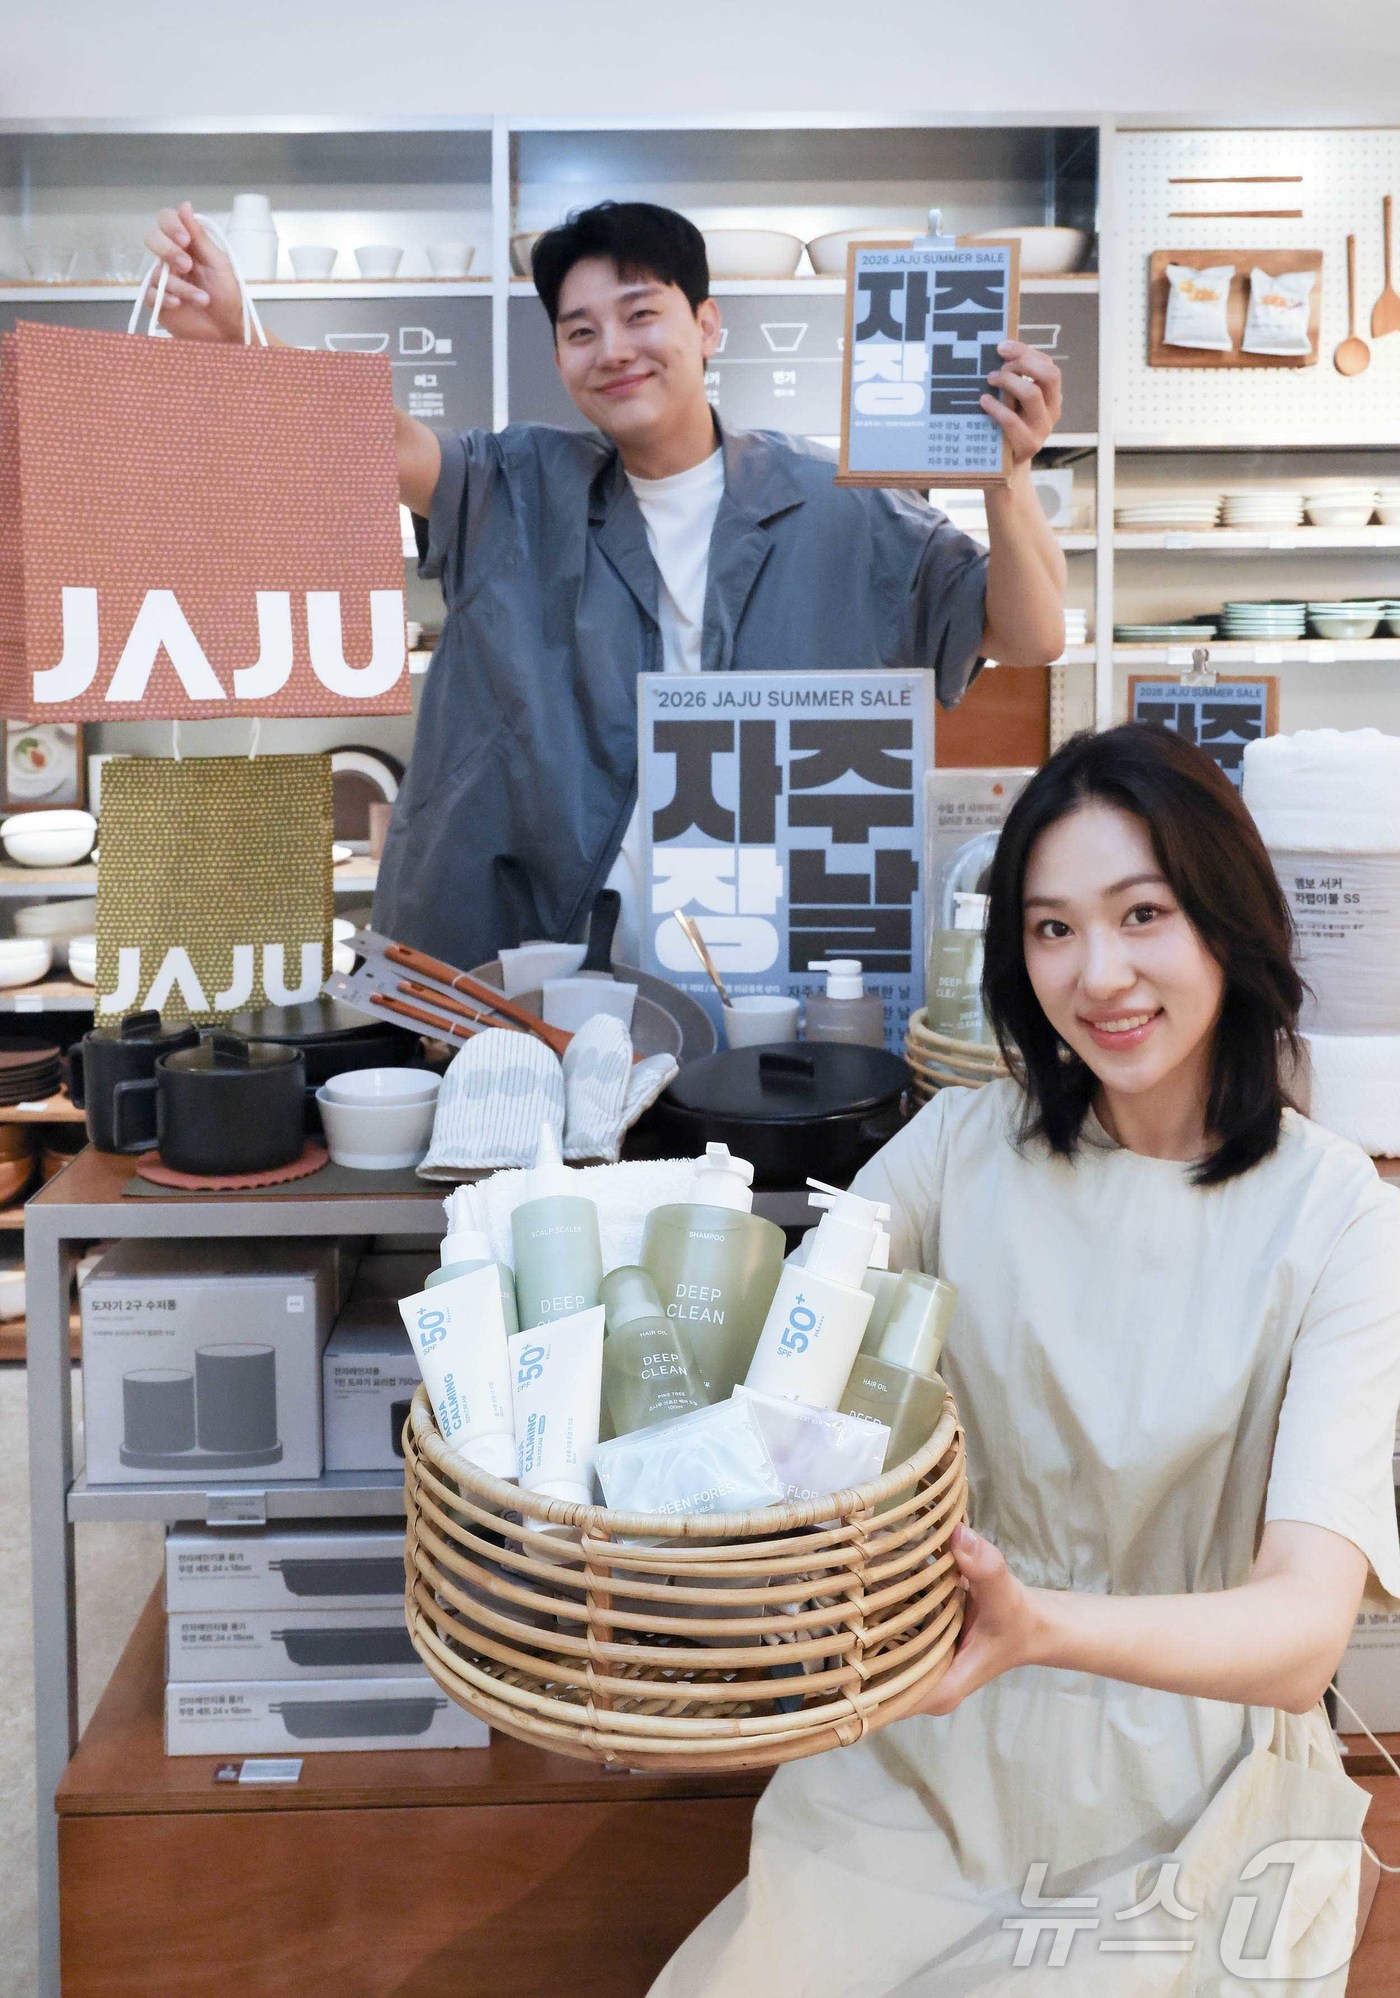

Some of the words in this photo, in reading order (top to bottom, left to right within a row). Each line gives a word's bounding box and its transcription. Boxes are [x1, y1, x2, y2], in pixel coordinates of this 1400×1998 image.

[863, 255, 889, 265] 2026
[892, 255, 920, 264] JAJU
[924, 253, 972, 264] SUMMER
[976, 253, 1004, 263] SALE
[856, 270, 1005, 341] 자주
[33, 586, 406, 703] JAJU
[658, 691, 706, 707] 2026
[713, 691, 761, 707] JAJU
[768, 690, 854, 707] SUMMER
[860, 690, 912, 707] SALE
[1165, 688, 1189, 698] JAJU
[1192, 688, 1234, 698] SUMMER
[1236, 688, 1262, 698] SALE
[653, 719, 914, 844] 자주
[1344, 893, 1360, 903] SS
[652, 848, 919, 973] 장날
[101, 943, 323, 1013] JAJU
[531, 1228, 553, 1238] SCALP
[556, 1226, 582, 1235] SCALER
[688, 1231, 725, 1242] SHAMPOO
[676, 1284, 722, 1302] DEEP
[91, 1300, 122, 1311] 도자기
[126, 1300, 142, 1310] 2구
[540, 1296, 585, 1314] DEEP
[666, 1304, 725, 1325] CLEAN
[640, 1329, 656, 1338] HAIR
[423, 1344, 437, 1356] SPF
[776, 1347, 792, 1358] SPF
[643, 1353, 679, 1366] DEEP
[641, 1365, 688, 1380] CLEAN
[863, 1378, 876, 1389] HAIR
[877, 1383, 888, 1392] OIL
[444, 1373, 462, 1431] CALMING
[438, 1403, 452, 1438] AQUA
[525, 1413, 537, 1472] CALMING
